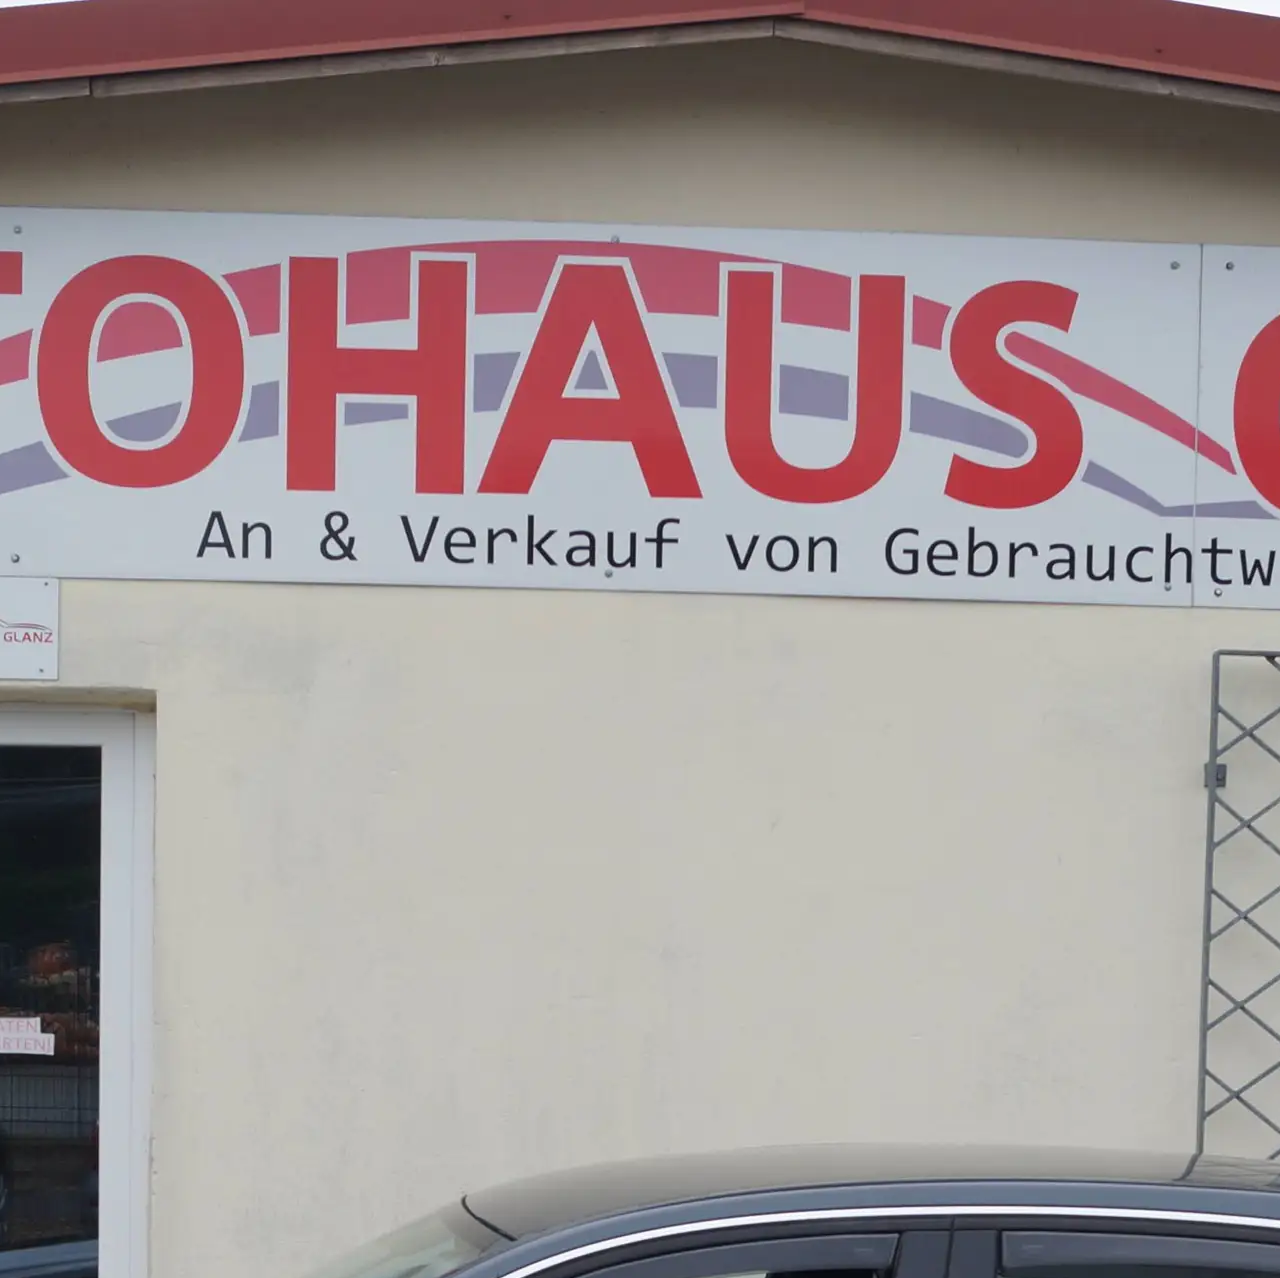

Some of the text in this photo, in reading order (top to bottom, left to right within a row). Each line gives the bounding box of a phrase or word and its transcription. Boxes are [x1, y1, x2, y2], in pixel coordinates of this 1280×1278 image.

[195, 509, 274, 561] An
[319, 509, 358, 562] &
[400, 513, 681, 571] Verkauf
[724, 533, 839, 574] von
[3, 630, 54, 645] GLANZ
